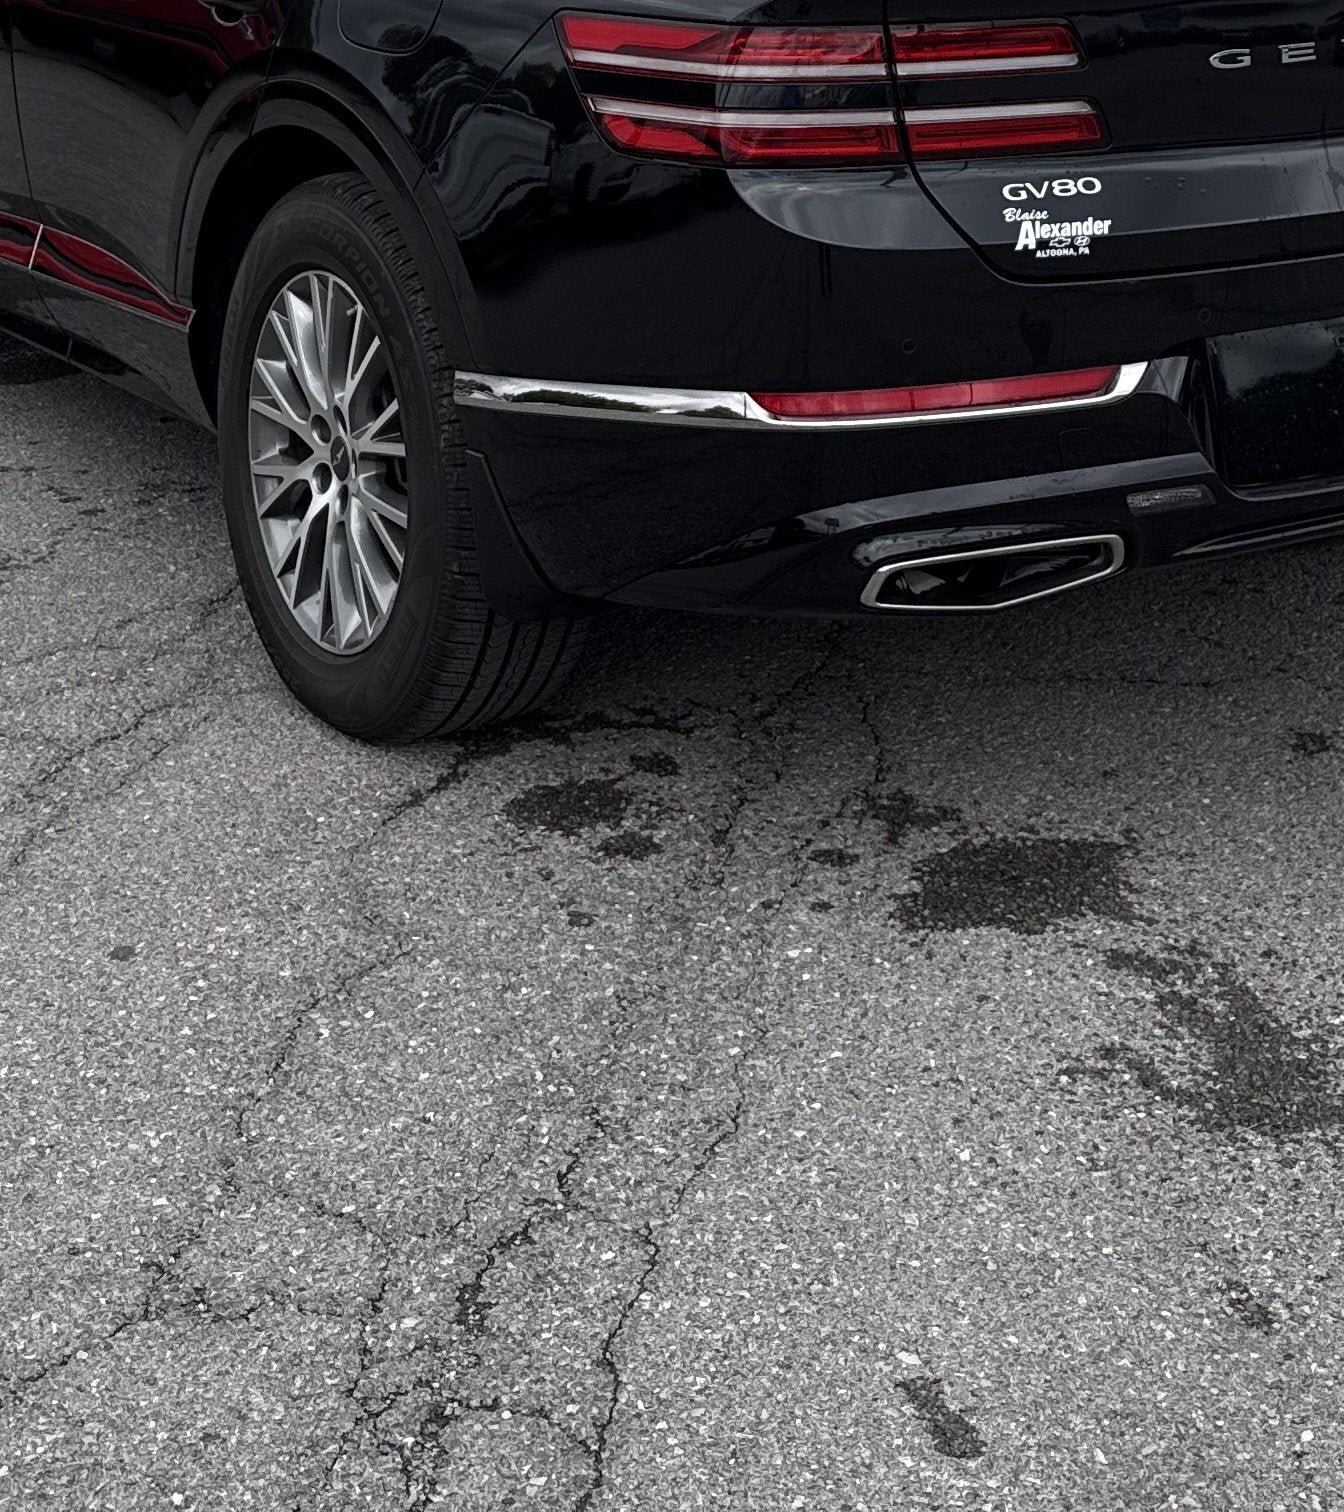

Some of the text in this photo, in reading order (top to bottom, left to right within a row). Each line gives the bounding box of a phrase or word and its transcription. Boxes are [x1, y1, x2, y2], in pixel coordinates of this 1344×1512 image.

[1002, 176, 1102, 201] GV80
[1002, 208, 1049, 222] Blaise
[1015, 216, 1112, 251] Alexander
